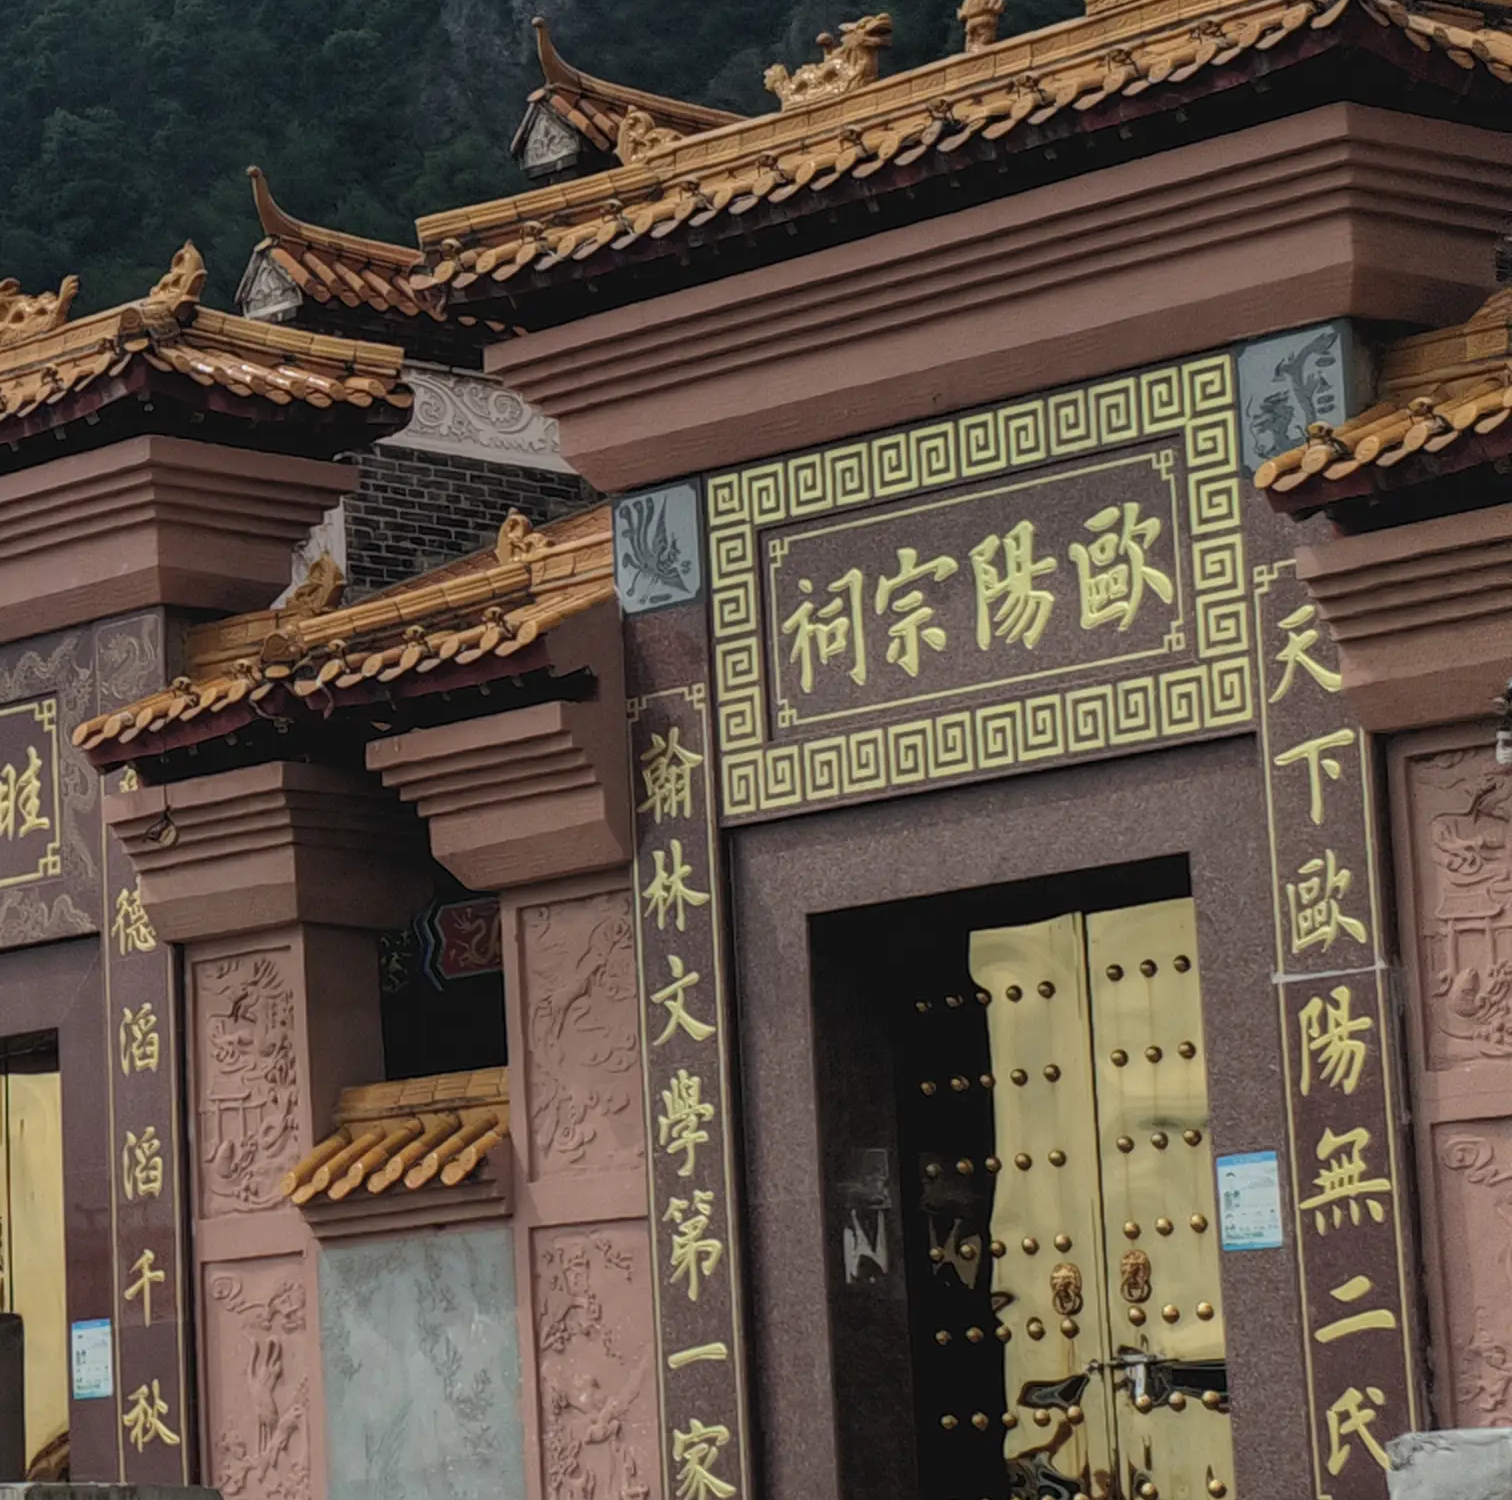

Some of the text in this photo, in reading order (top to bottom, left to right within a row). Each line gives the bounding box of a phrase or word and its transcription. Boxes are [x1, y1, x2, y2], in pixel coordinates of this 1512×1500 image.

[782, 501, 1174, 695] 歐陽宗祠
[1268, 603, 1395, 1477] 天下歐陽無二氏
